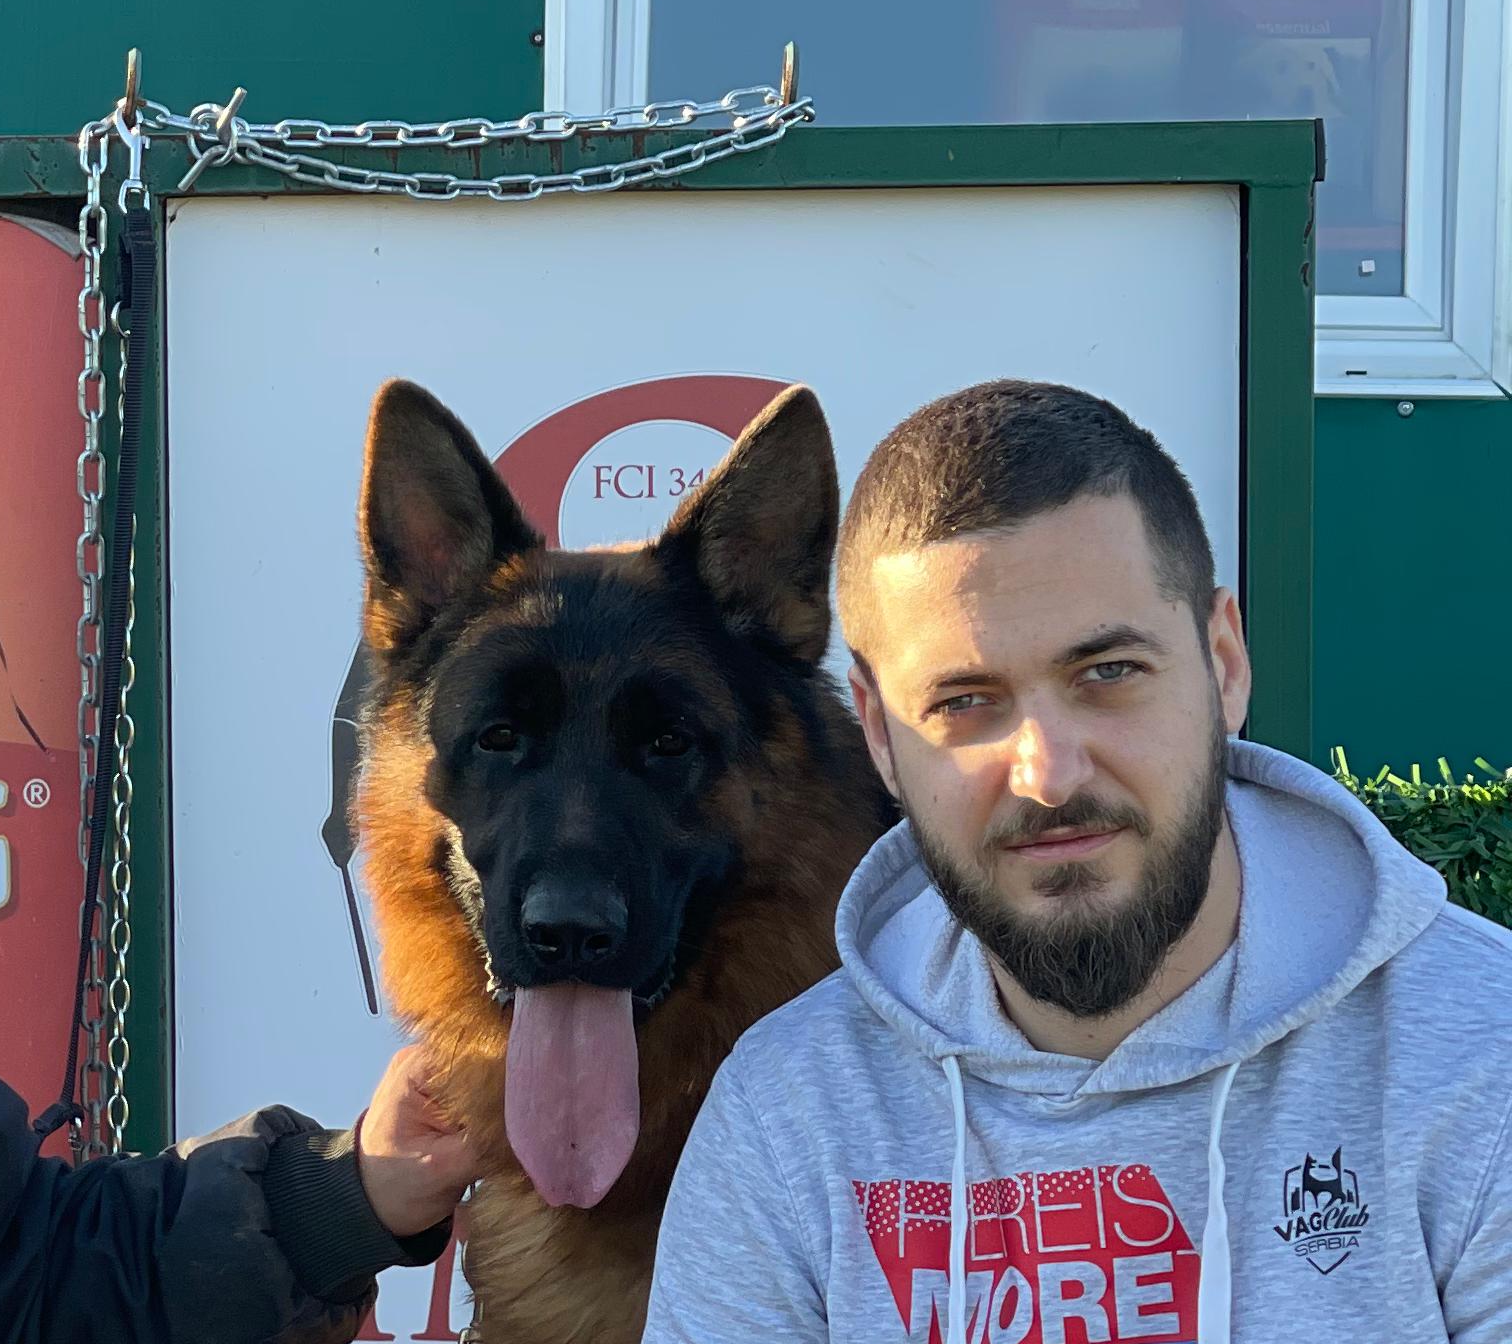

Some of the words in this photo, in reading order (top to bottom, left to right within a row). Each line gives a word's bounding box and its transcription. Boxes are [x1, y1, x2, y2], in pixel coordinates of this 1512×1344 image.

[593, 464, 657, 499] FCI
[1273, 1211, 1322, 1243] VAG
[1294, 1235, 1360, 1257] SERBIA
